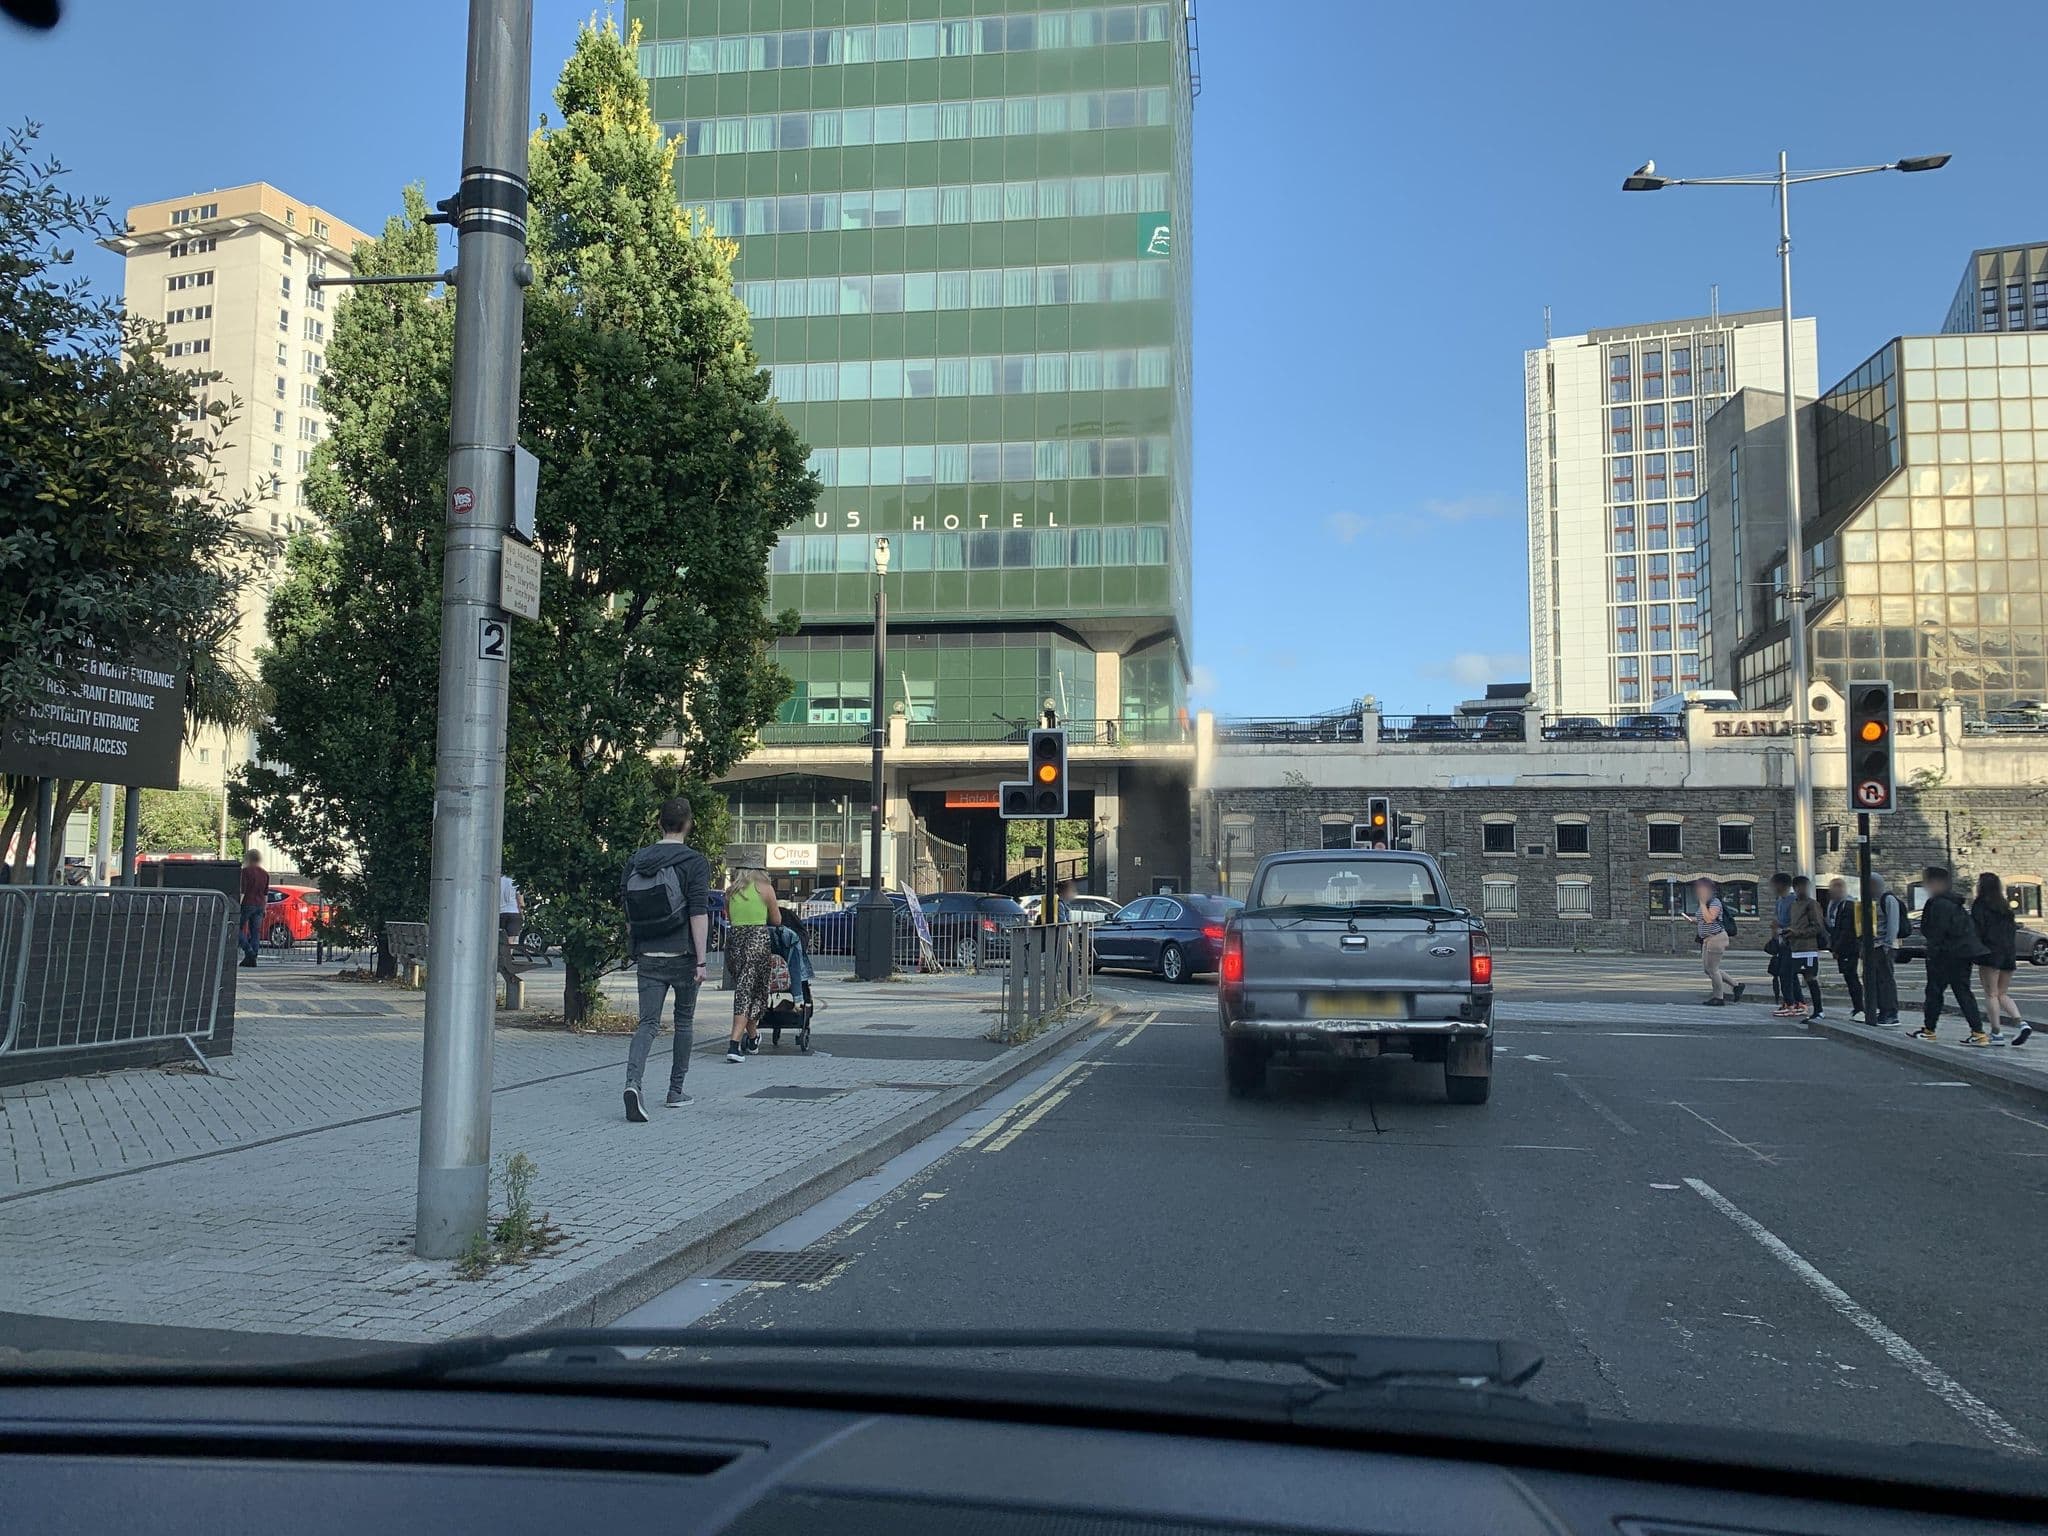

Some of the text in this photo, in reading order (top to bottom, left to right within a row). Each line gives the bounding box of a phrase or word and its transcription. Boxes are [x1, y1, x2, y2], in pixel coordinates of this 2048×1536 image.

[912, 512, 1058, 531] HOTEL
[485, 624, 505, 656] 2
[90, 659, 97, 675] &
[131, 667, 176, 689] ENTRANCE
[47, 677, 156, 710] RESRANT ENTRANCE
[30, 702, 140, 732] HOSPITALITY ENTRANCE
[1712, 718, 1837, 738] HARLH
[92, 737, 128, 756] ACCESS
